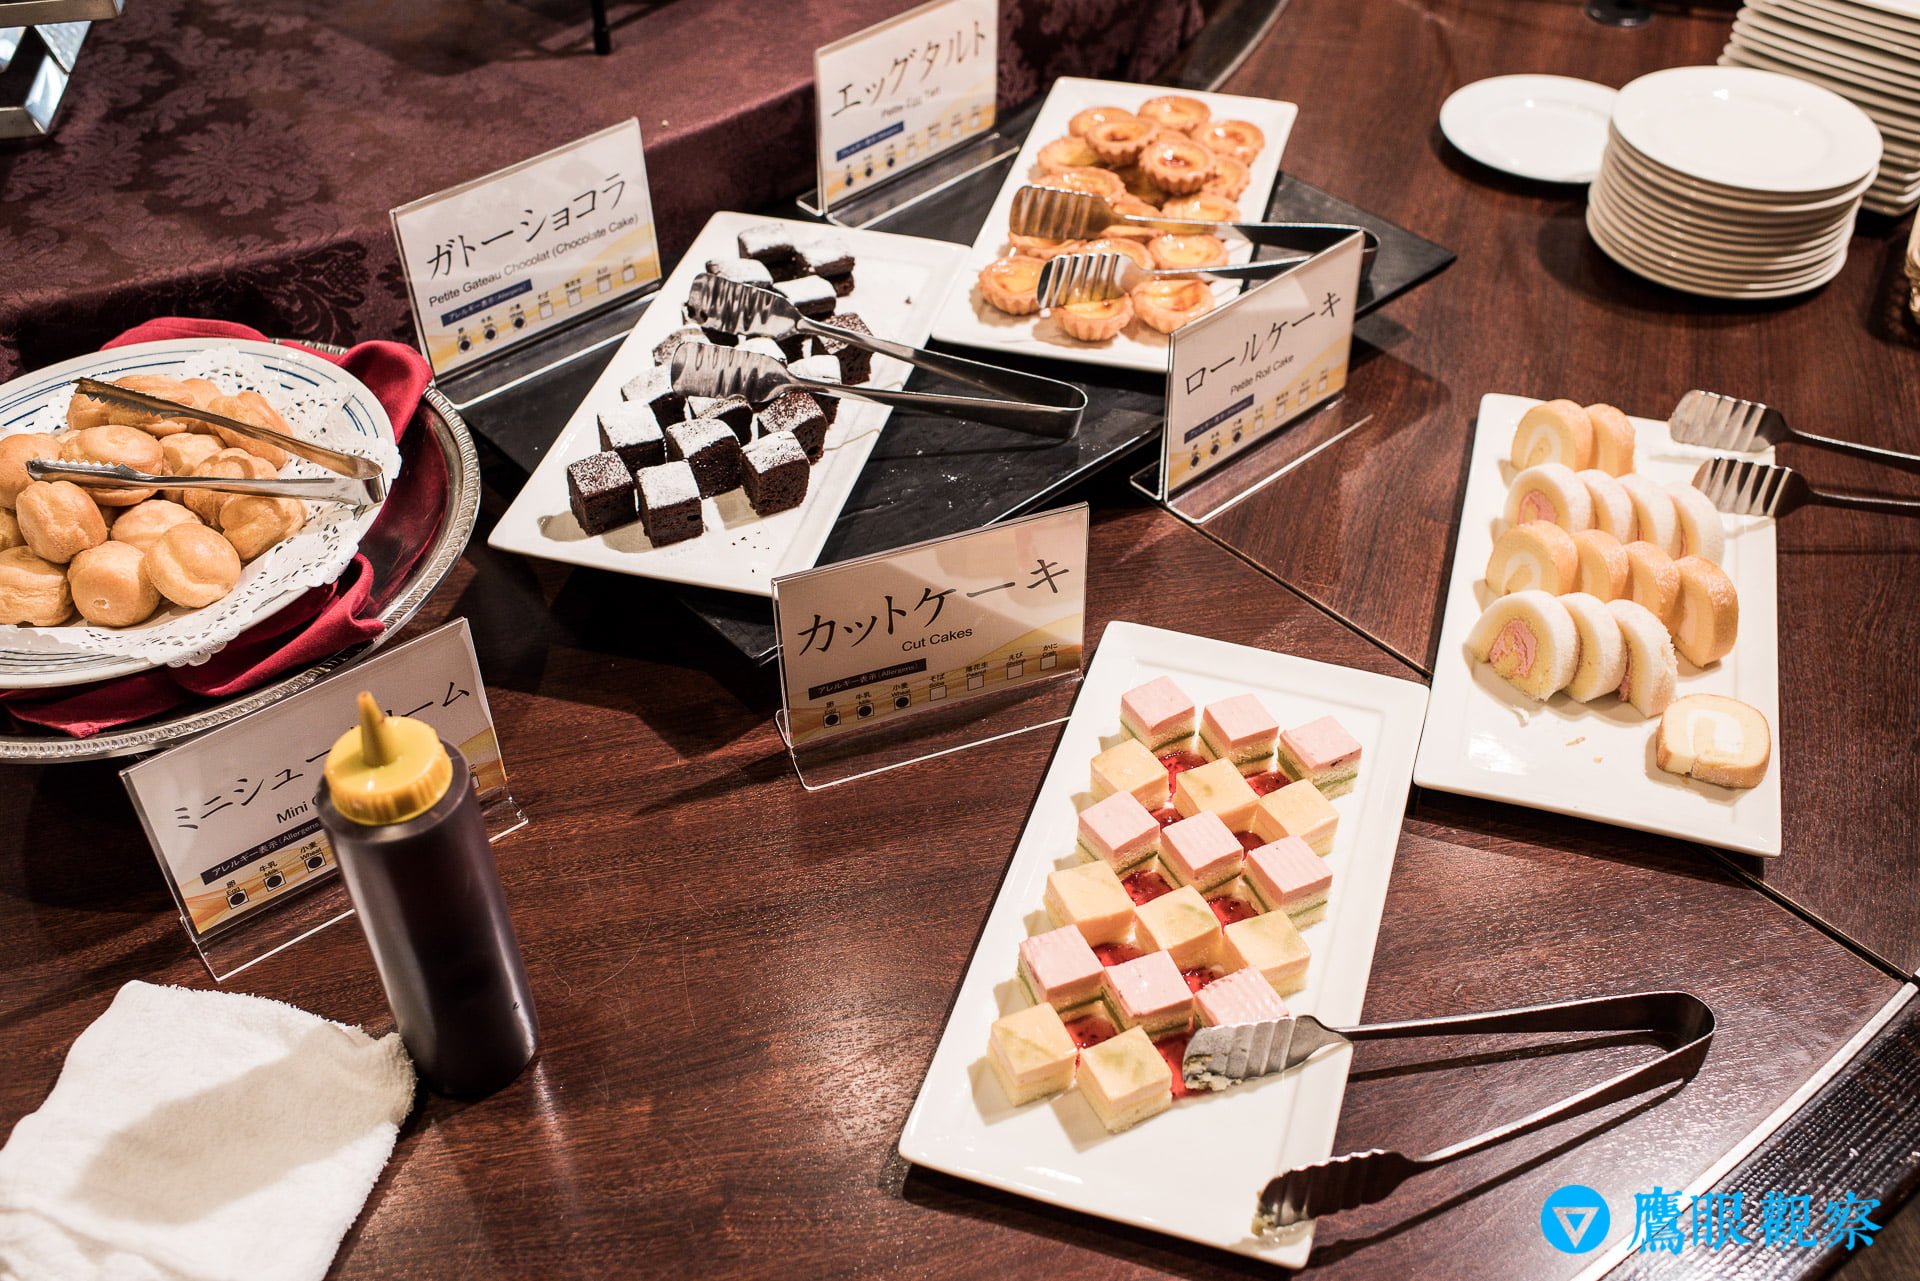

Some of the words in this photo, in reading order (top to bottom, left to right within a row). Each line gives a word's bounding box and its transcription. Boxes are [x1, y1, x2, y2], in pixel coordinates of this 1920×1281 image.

[832, 21, 985, 117] エッグタルト
[427, 173, 626, 280] ガトーショコラ
[429, 287, 460, 307] Petite
[504, 250, 551, 277] Chocolat
[552, 229, 607, 259] (Chocolate
[608, 213, 639, 234] Cake)
[1186, 291, 1341, 395] ロールケーキ
[1256, 365, 1272, 382] Roll
[1273, 354, 1294, 372] Cake
[797, 559, 1069, 656] カットケーキ
[901, 637, 928, 652] Cut
[930, 627, 973, 646] Cakes
[173, 681, 470, 830] ミニシューーム
[276, 801, 308, 824] Mini
